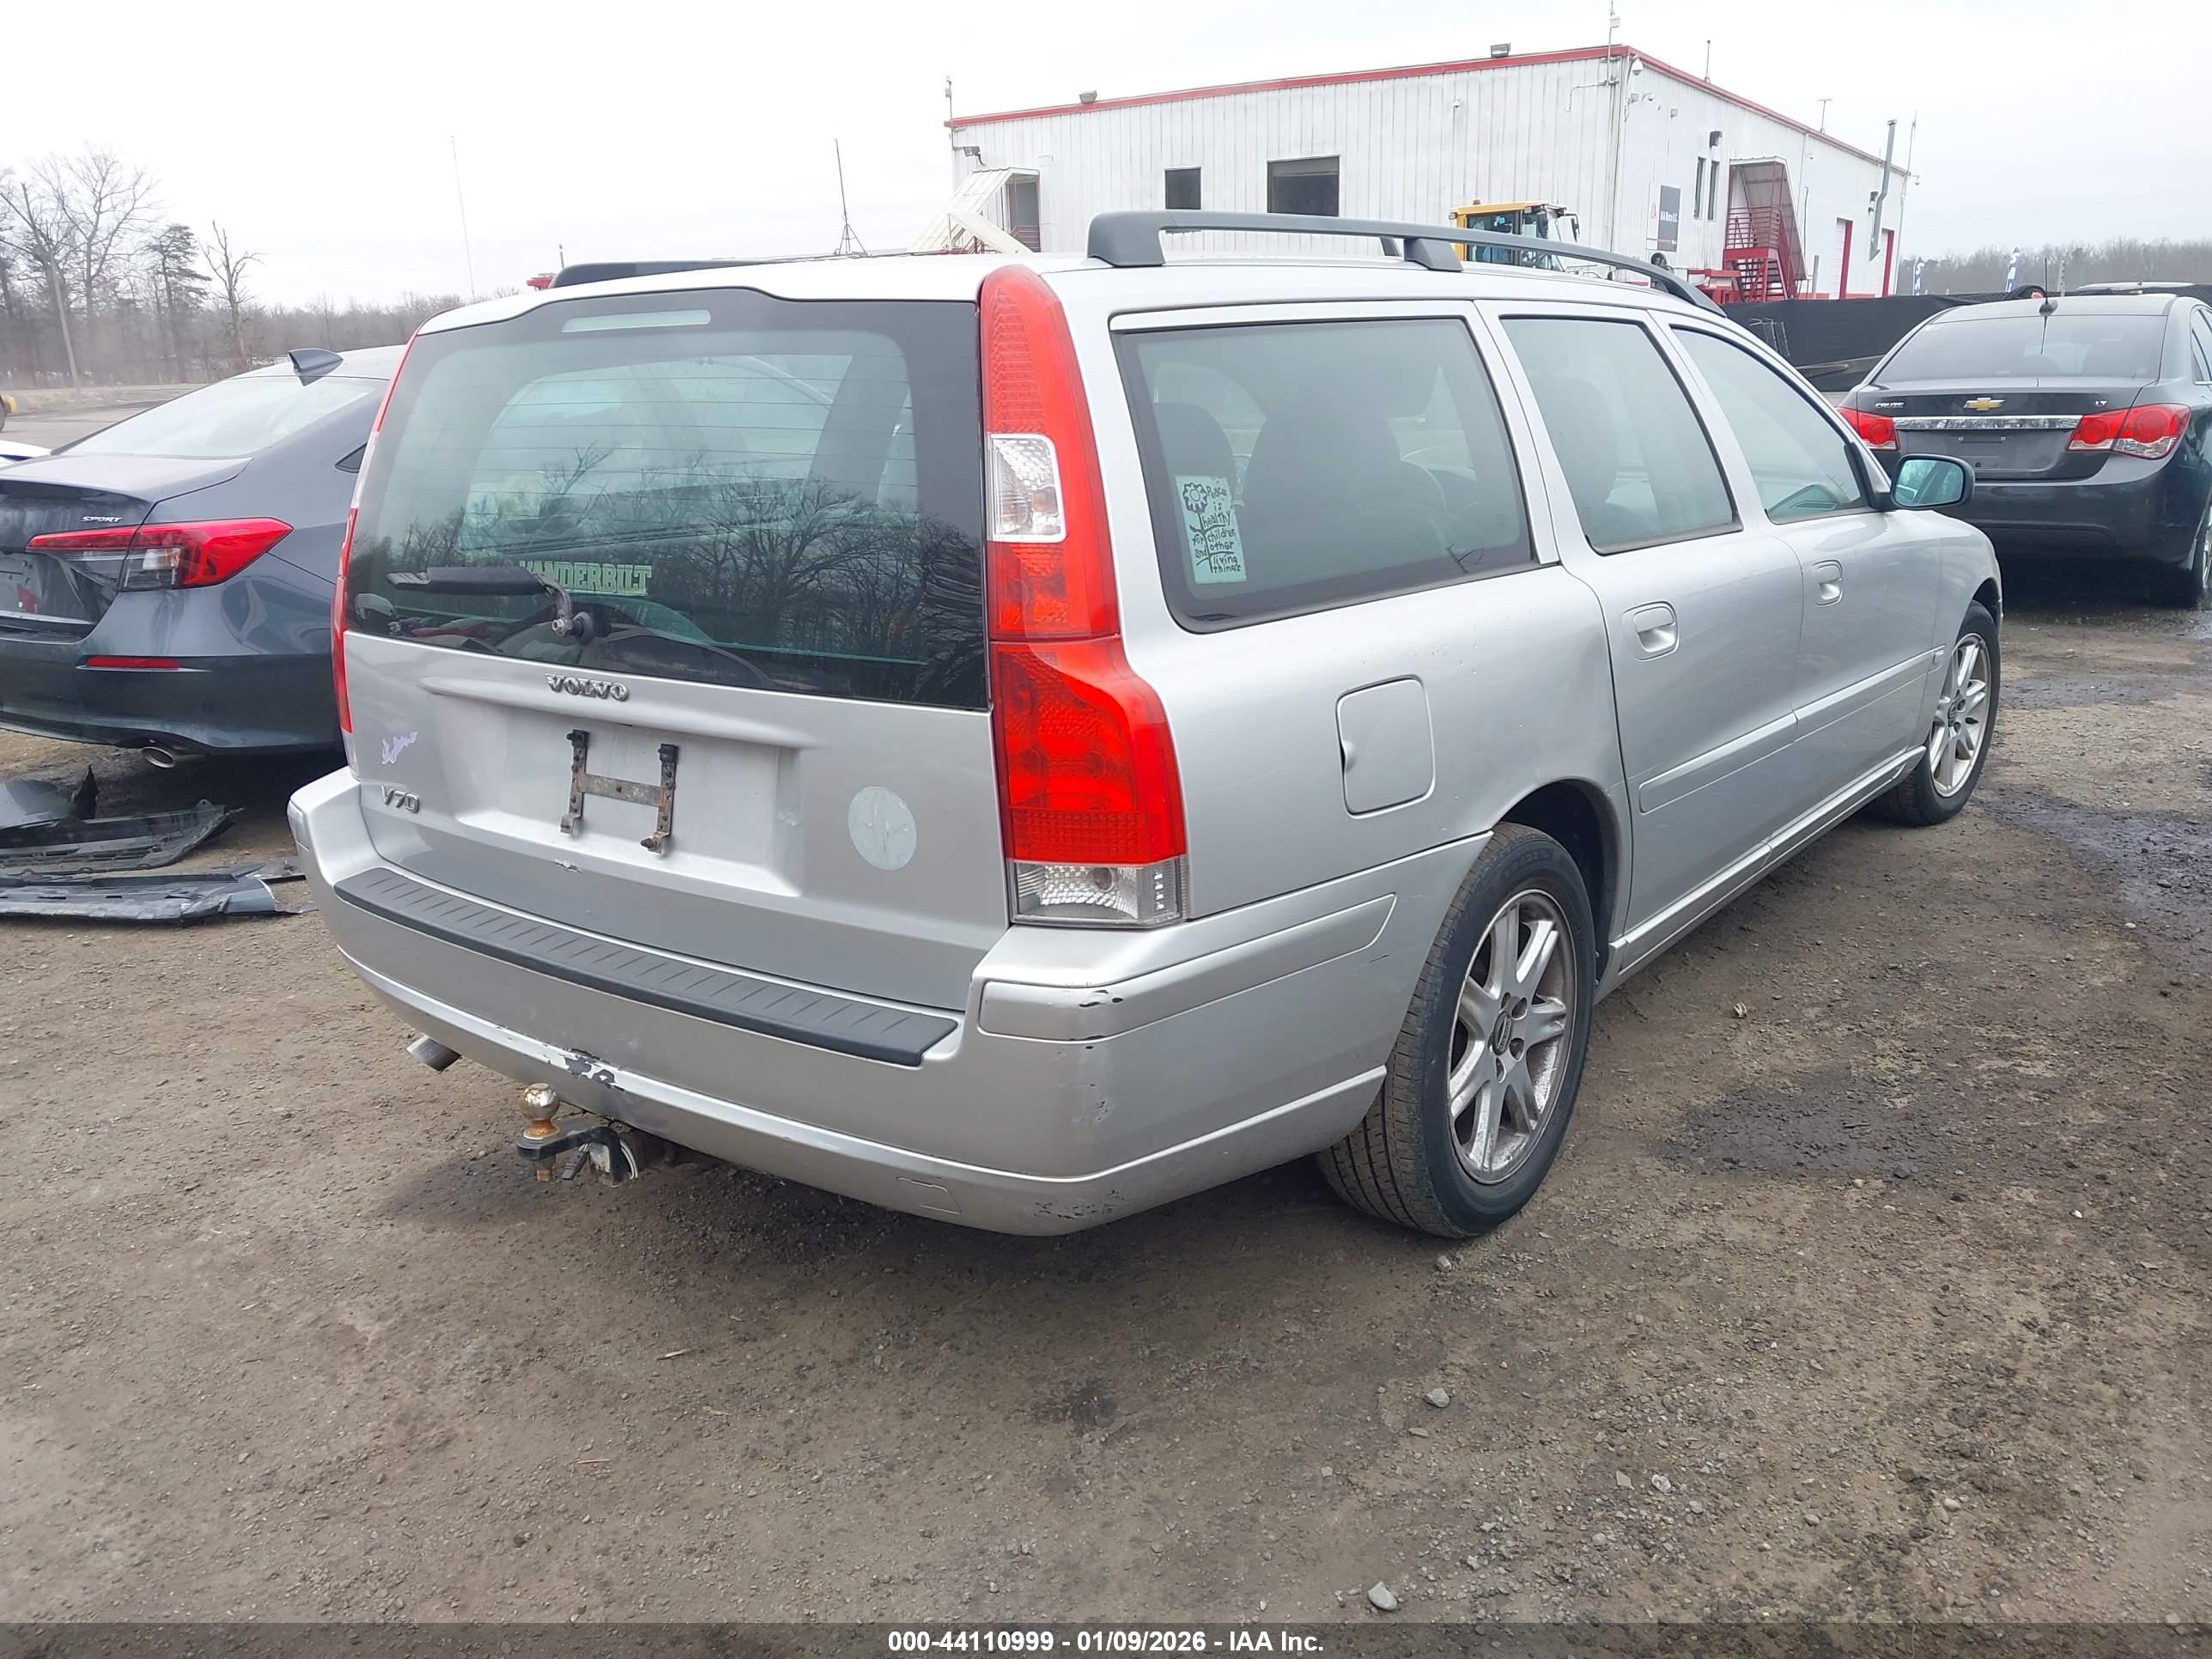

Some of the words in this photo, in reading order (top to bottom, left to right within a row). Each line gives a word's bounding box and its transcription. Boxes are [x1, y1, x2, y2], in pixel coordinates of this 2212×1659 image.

[1213, 501, 1222, 511] is
[1202, 510, 1231, 528] healthy
[1192, 533, 1204, 546] for
[1207, 528, 1237, 543] children
[1194, 545, 1207, 558] and
[1209, 540, 1235, 550] other
[1212, 555, 1238, 568] living
[1212, 564, 1242, 574] things
[544, 673, 630, 702] VOLVO
[380, 784, 420, 814] V70
